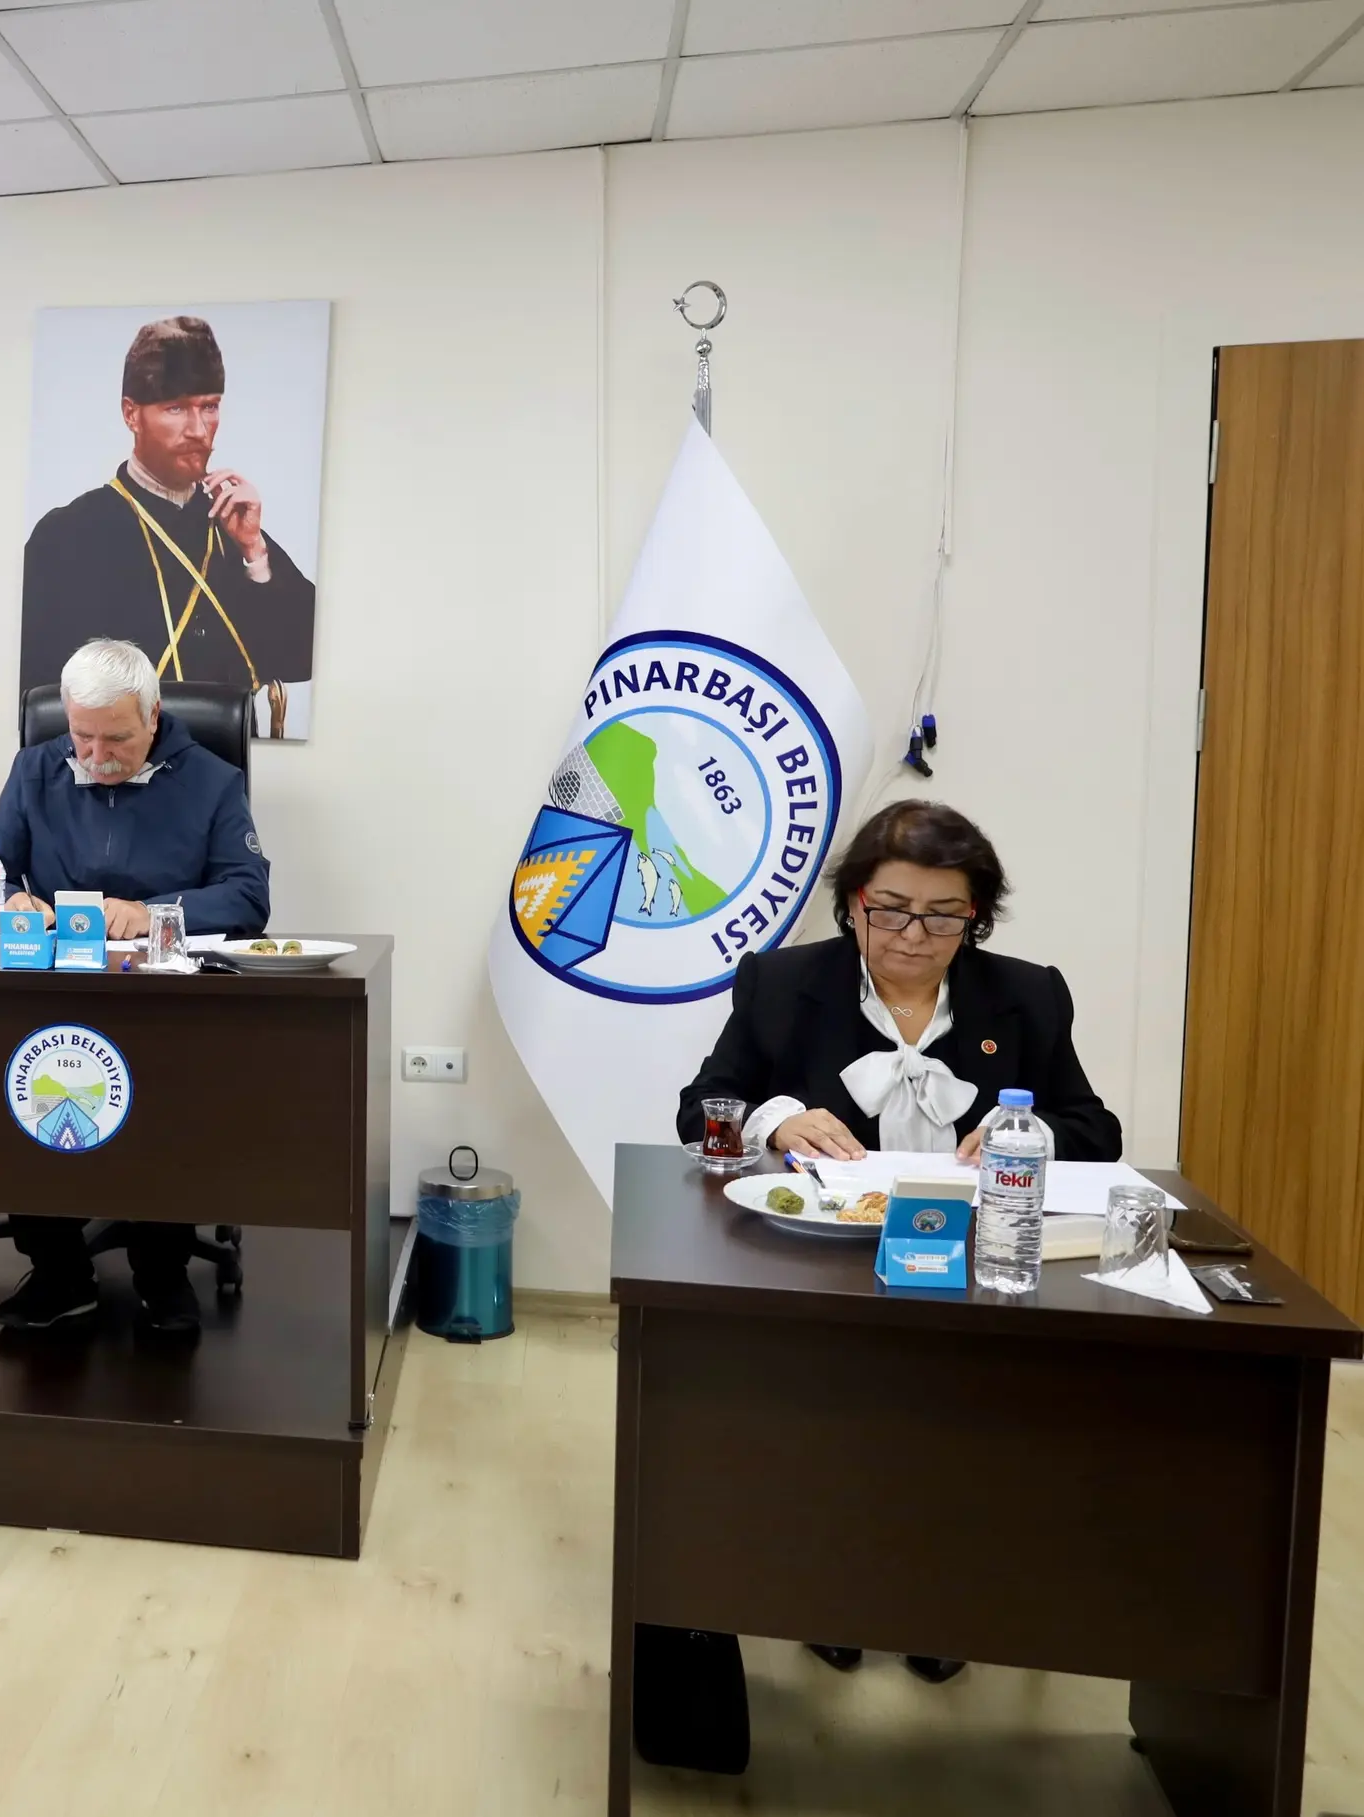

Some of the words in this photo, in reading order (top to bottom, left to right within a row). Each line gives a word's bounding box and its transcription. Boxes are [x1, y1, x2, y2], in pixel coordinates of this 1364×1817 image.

[583, 660, 789, 742] PINARBAŞI
[711, 744, 818, 964] BELEDİYESİ
[697, 755, 742, 816] 1863
[16, 1034, 65, 1101] PINARBAŞI
[71, 1034, 122, 1108] BELEDİYESİ
[57, 1059, 82, 1068] 1863
[994, 1170, 1035, 1188] Tekir
